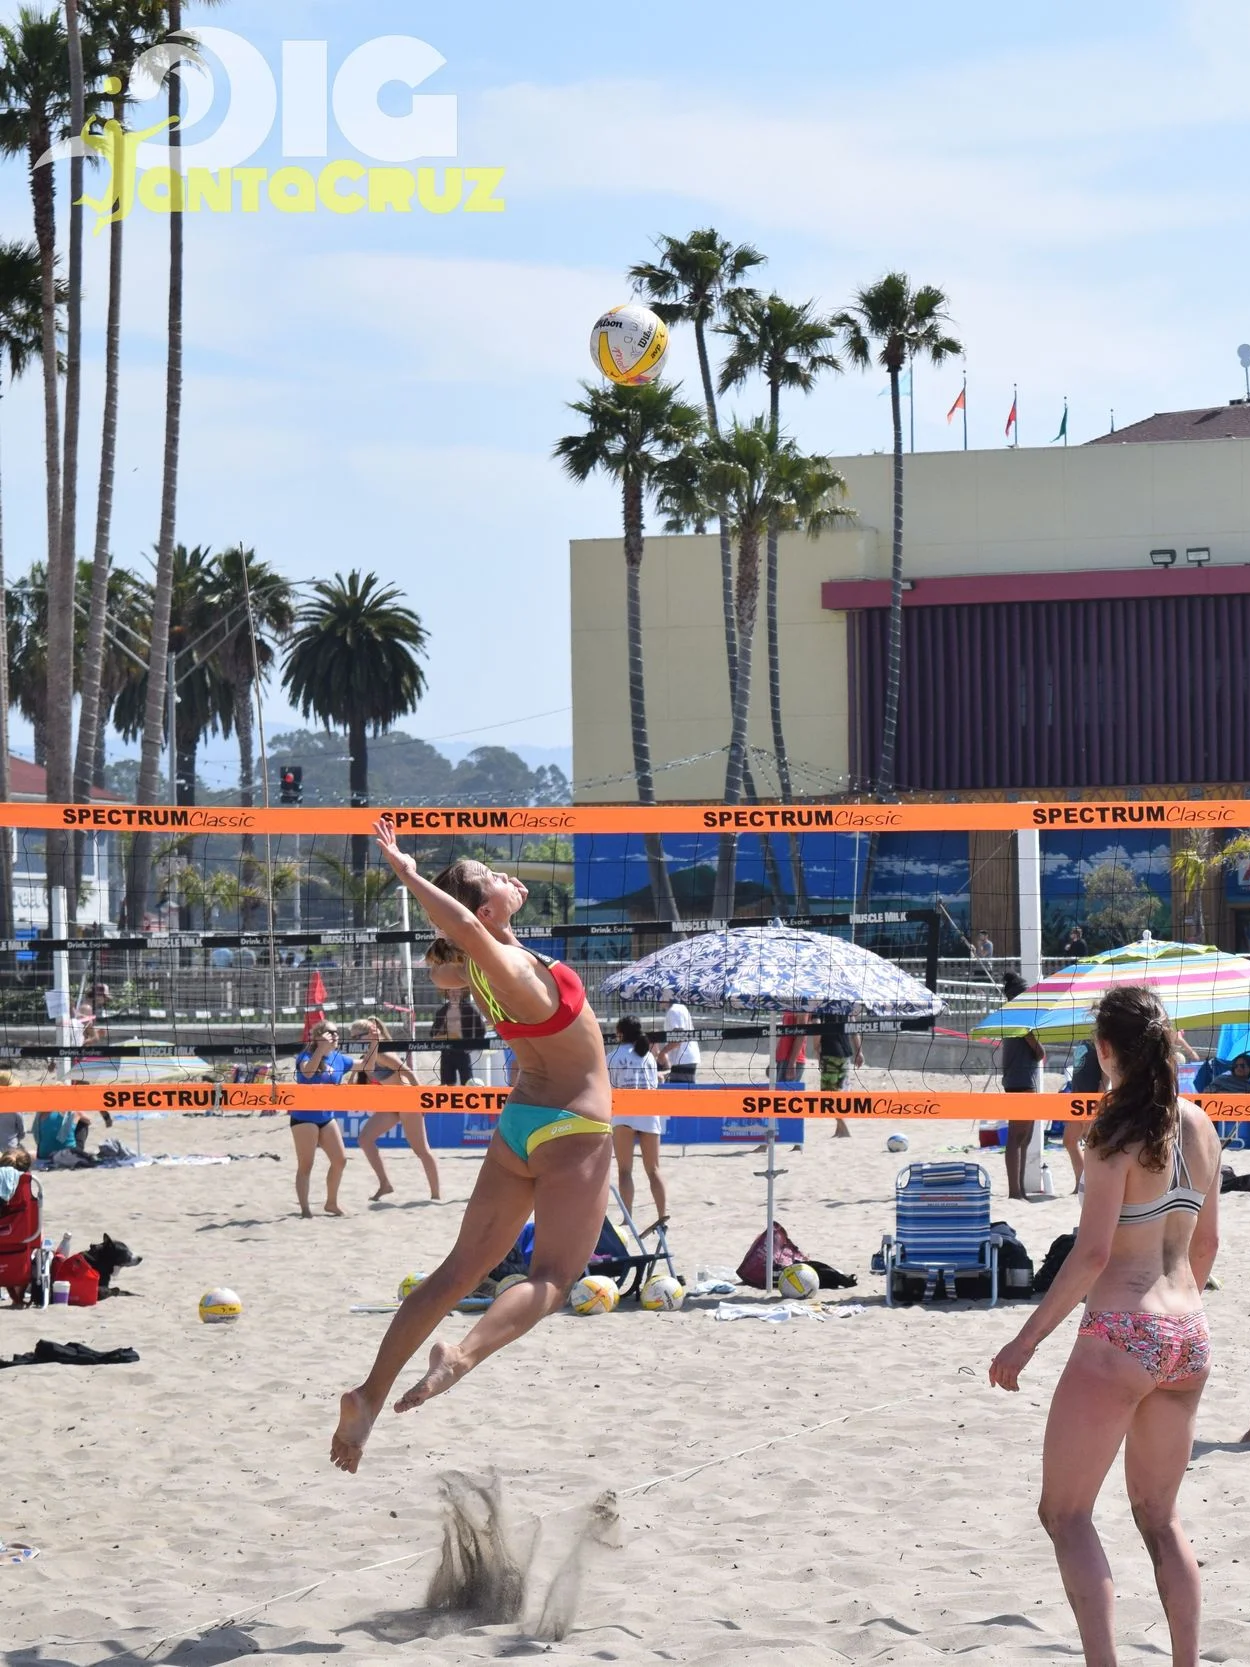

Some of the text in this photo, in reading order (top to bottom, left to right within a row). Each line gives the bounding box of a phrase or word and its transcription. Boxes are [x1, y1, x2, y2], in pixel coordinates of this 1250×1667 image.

[672, 921, 705, 932] MUSCLE
[705, 920, 729, 931] MILK
[849, 913, 882, 923] MUSCLE
[883, 912, 907, 922] MILK
[844, 1023, 877, 1033] MUSCLE
[878, 1021, 901, 1032] MILK
